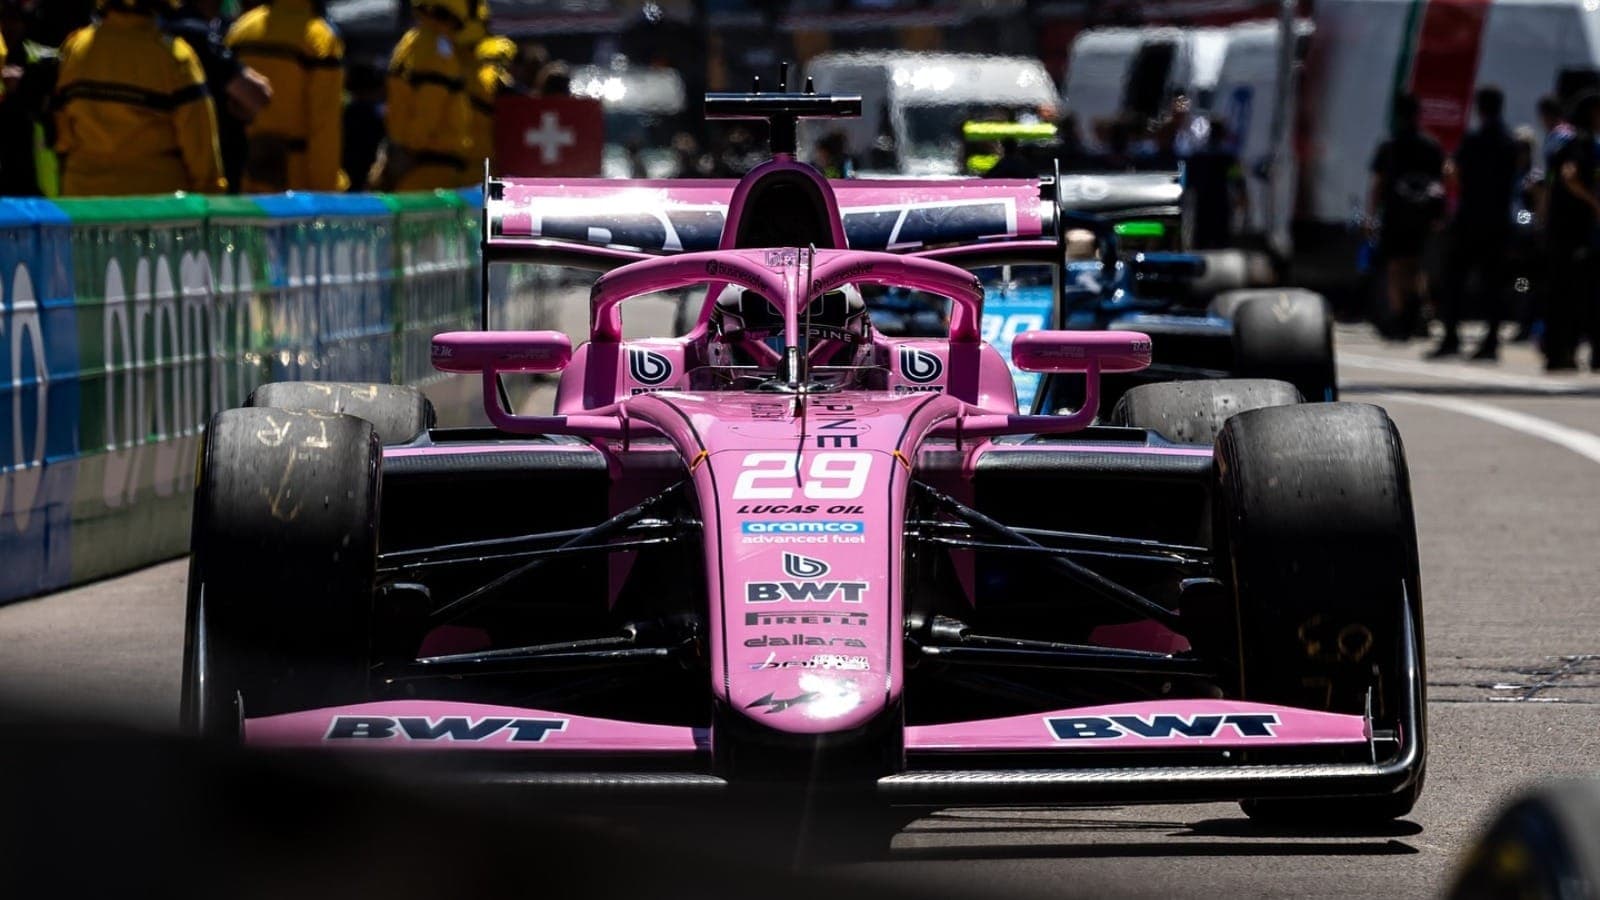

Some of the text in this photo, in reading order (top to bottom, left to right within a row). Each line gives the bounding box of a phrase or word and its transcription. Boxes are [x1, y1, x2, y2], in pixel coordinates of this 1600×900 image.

[776, 328, 853, 343] APINE
[809, 397, 859, 448] PINE
[732, 453, 873, 500] 29
[736, 505, 865, 514] LUCAS OIL
[747, 521, 859, 532] aramco
[742, 534, 866, 544] advanced fuel
[746, 582, 868, 602] BWT
[745, 611, 868, 626] PIRELLI
[744, 633, 867, 648] dallara
[325, 715, 567, 742] BWT
[1044, 713, 1281, 740] BWT
